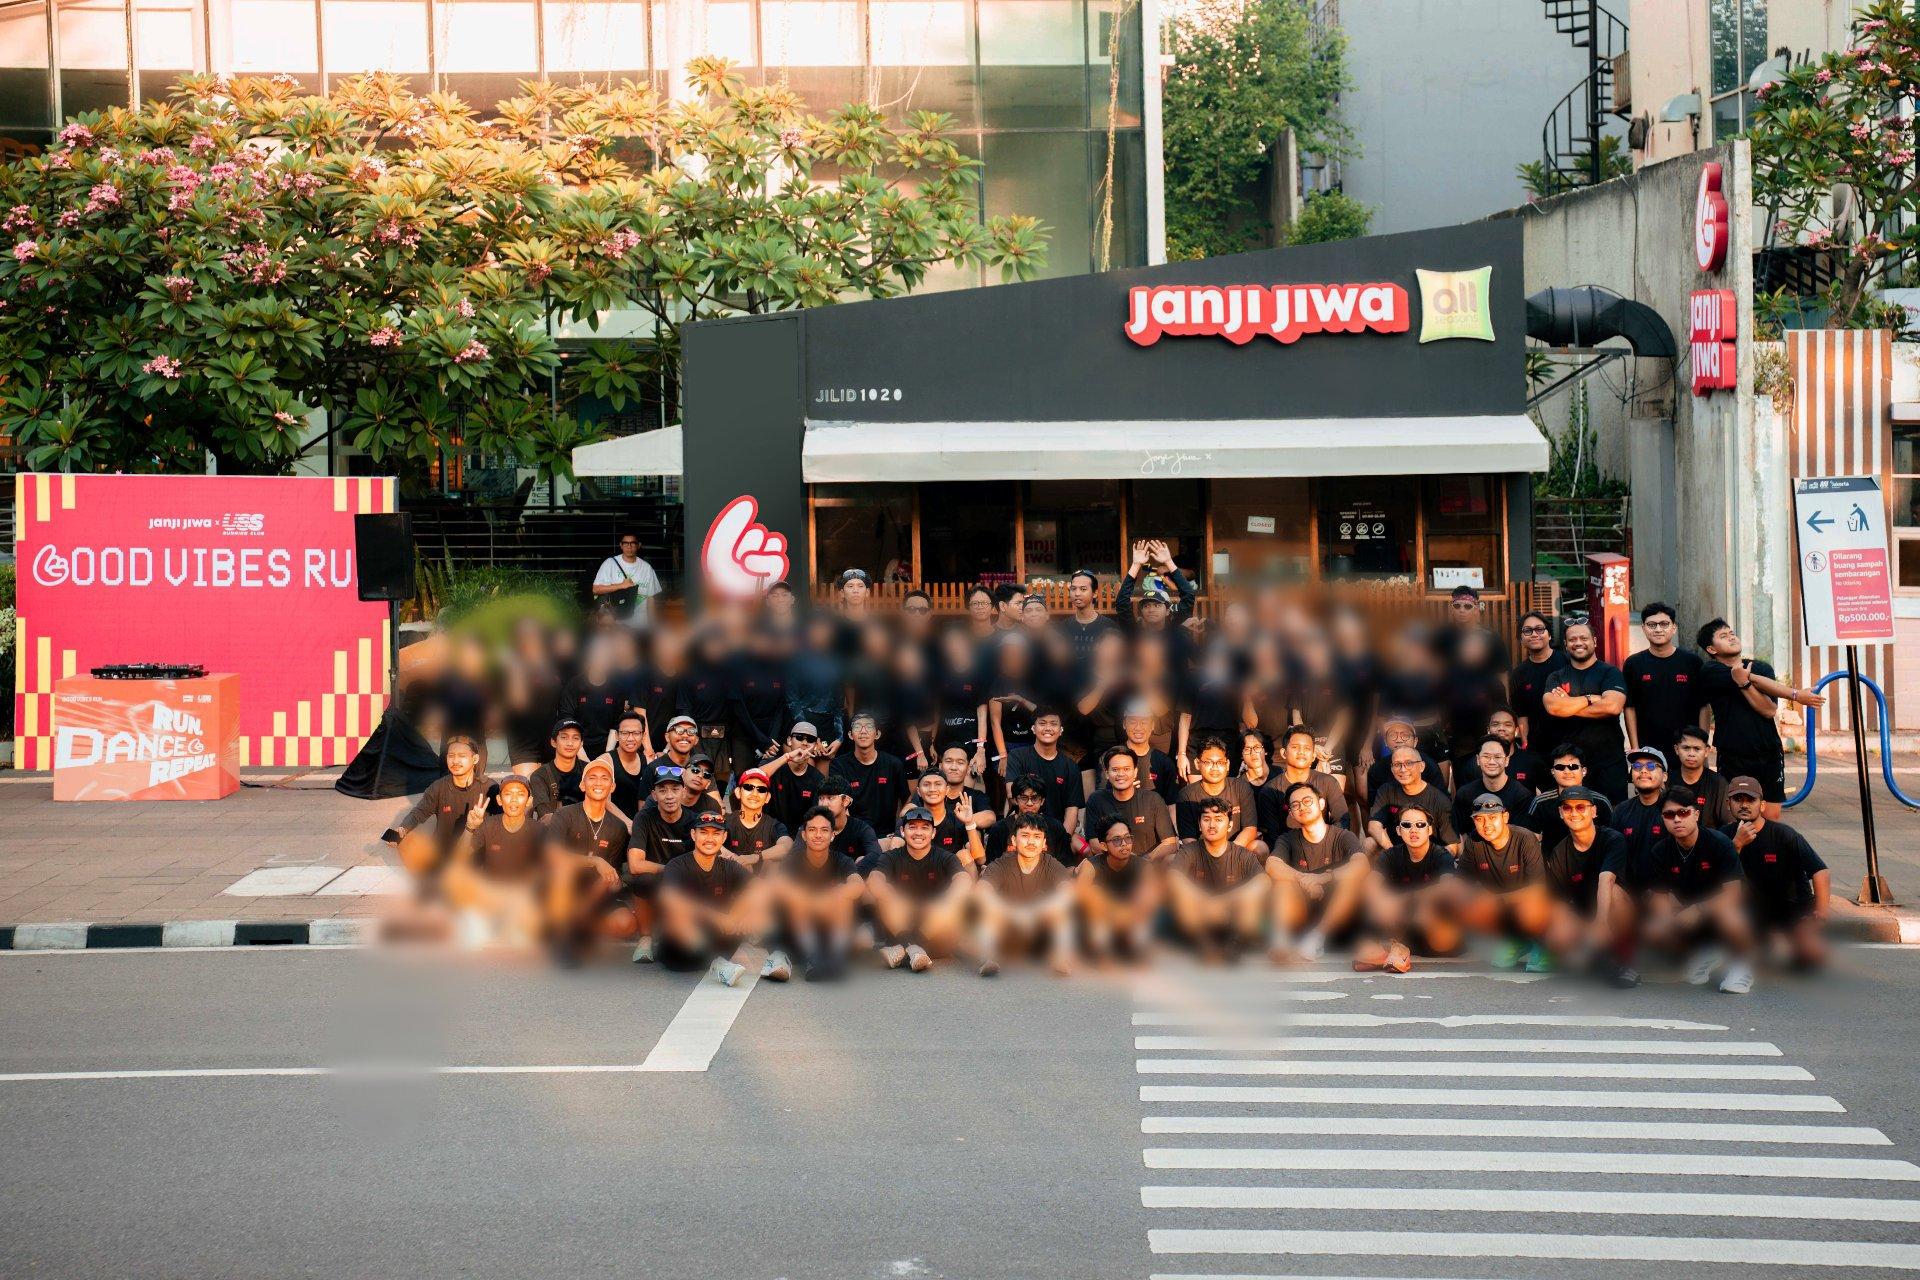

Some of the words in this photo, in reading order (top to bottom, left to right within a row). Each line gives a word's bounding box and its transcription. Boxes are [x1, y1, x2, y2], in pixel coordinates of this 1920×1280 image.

[1129, 288, 1261, 335] janji
[1271, 287, 1395, 334] jiwa
[1433, 280, 1478, 315] all
[1690, 293, 1720, 341] janji
[1691, 341, 1720, 387] jiwa
[815, 388, 857, 402] JILID
[149, 518, 181, 529] janji
[182, 518, 212, 530] jiwa
[164, 548, 291, 587] VIBES
[304, 548, 359, 588] RU
[1834, 562, 1856, 570] buang
[1856, 560, 1884, 569] sampah
[1834, 570, 1881, 578] sembarangan
[1839, 611, 1890, 624] Rp500.000,-
[54, 725, 188, 769] DANCE
